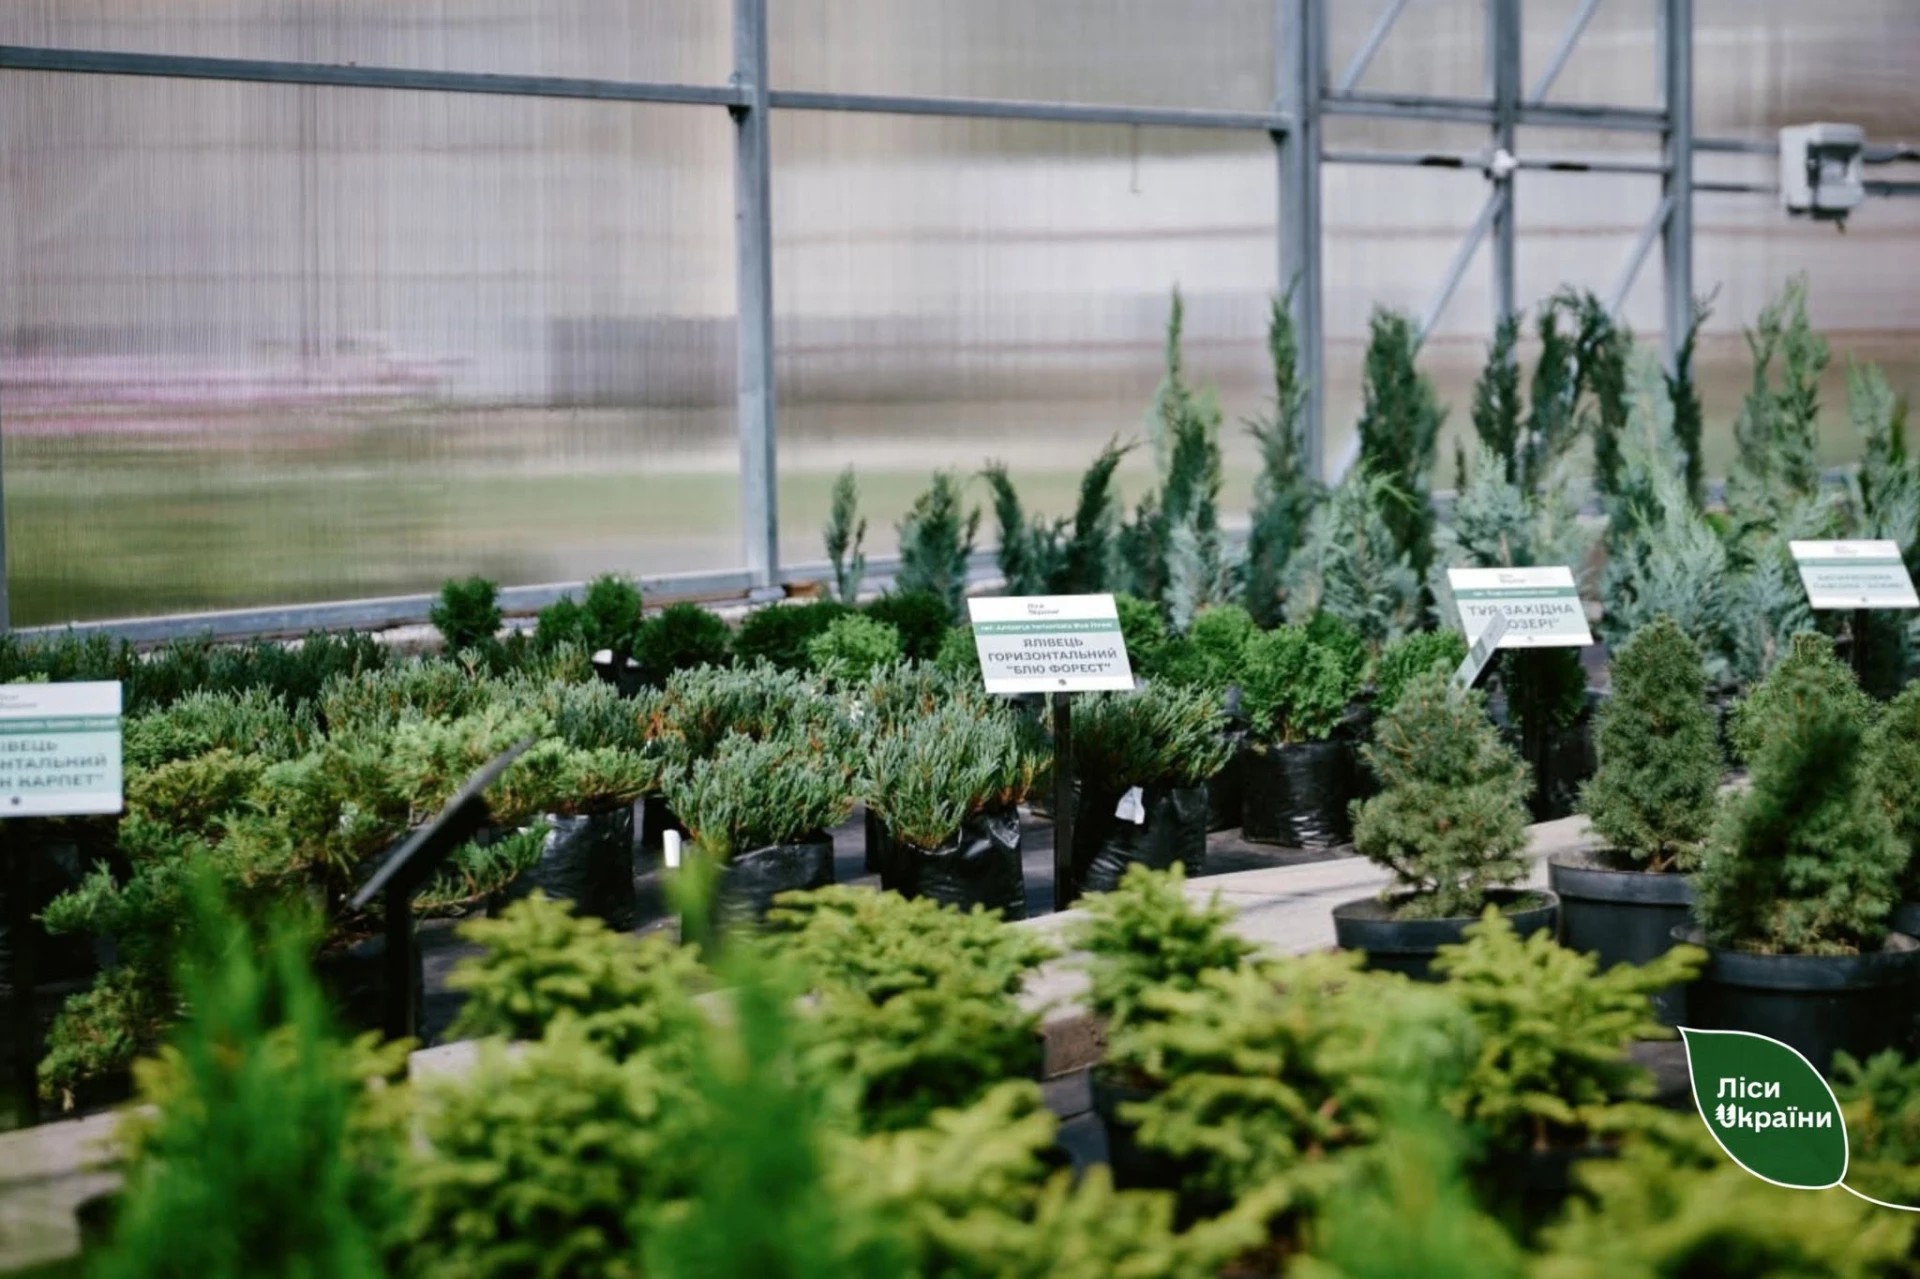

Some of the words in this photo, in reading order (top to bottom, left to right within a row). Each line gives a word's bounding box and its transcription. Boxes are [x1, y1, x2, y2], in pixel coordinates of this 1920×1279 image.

[1503, 603, 1575, 616] ЗАХІДНА
[1023, 637, 1084, 648] ЯЛІВЕЦЬ
[988, 648, 1117, 662] ГОРИЗОНТАЛЬНИЙ
